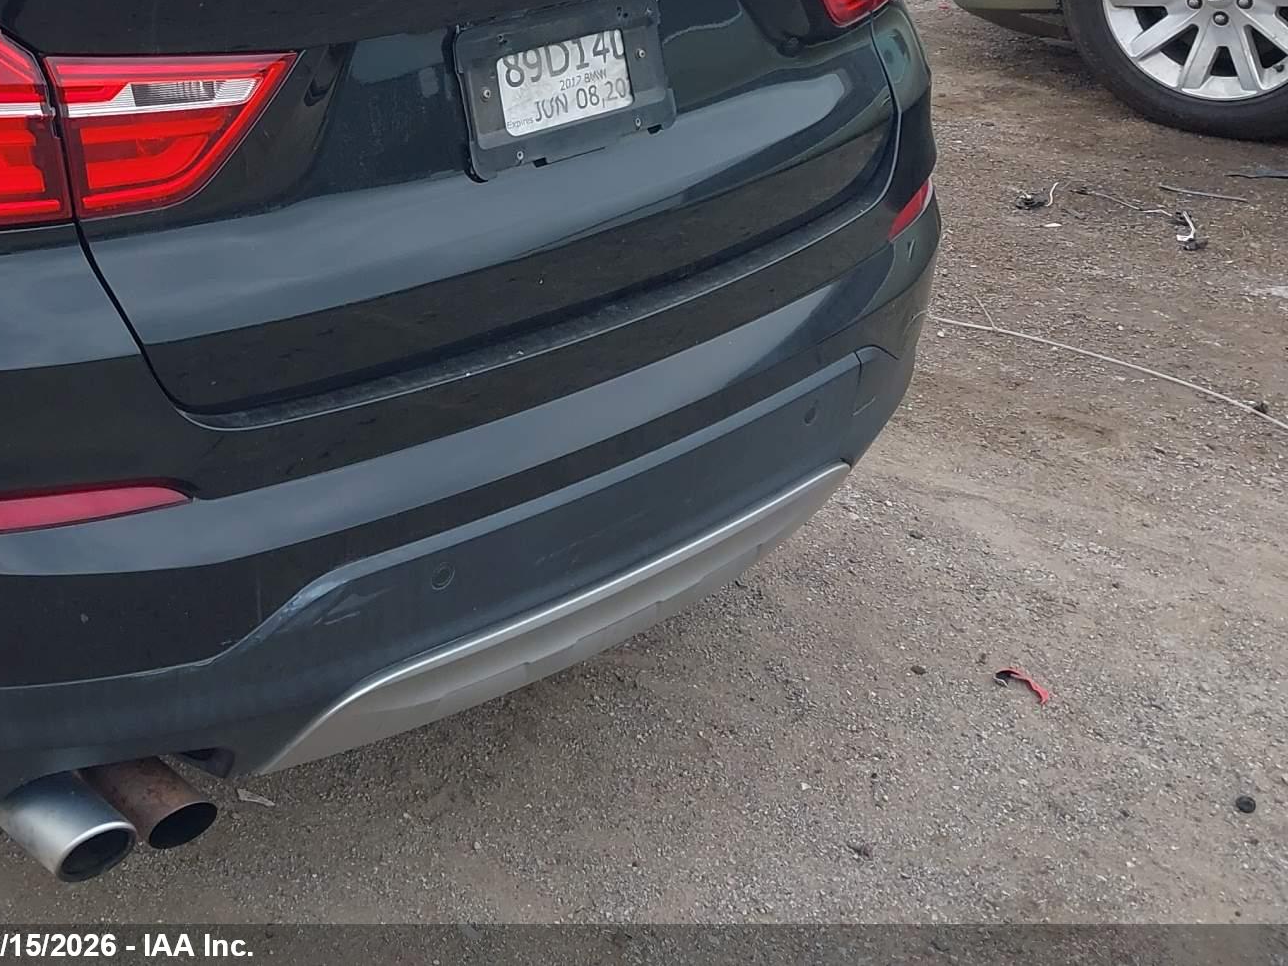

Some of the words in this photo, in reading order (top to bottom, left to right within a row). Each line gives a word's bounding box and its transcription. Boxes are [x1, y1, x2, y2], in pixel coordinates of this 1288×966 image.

[559, 75, 582, 91] 2017
[584, 68, 607, 83] BMW
[507, 117, 534, 129] Expires
[534, 93, 568, 122] JUN
